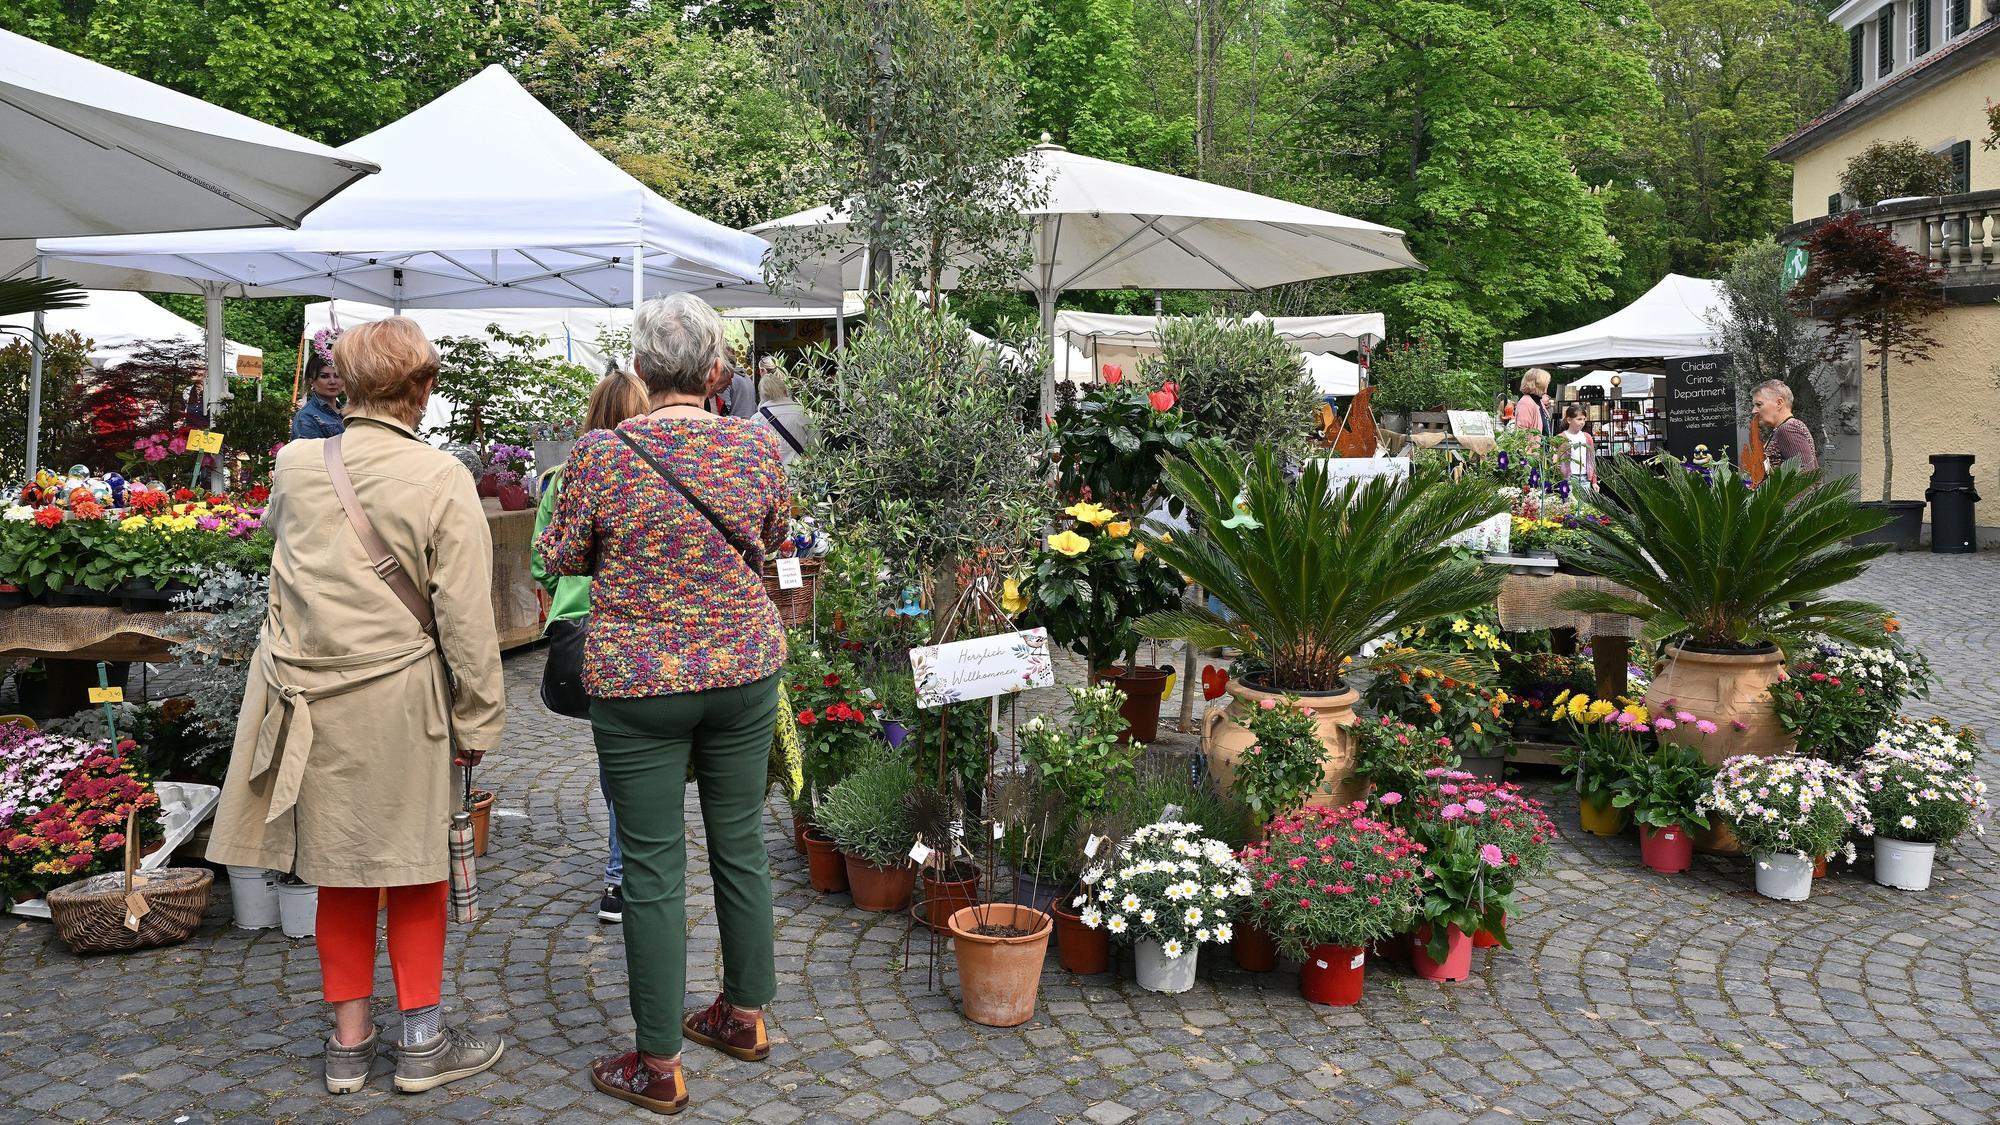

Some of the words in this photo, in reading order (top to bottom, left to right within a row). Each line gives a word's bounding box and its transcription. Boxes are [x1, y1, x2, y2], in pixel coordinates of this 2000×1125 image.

[176, 169, 231, 198] www.musculus.de
[1681, 361, 1717, 372] Chicken
[1686, 374, 1713, 385] Crime
[1674, 387, 1726, 400] Department
[958, 646, 1006, 665] Herzlich
[952, 668, 1018, 686] Willkommen
